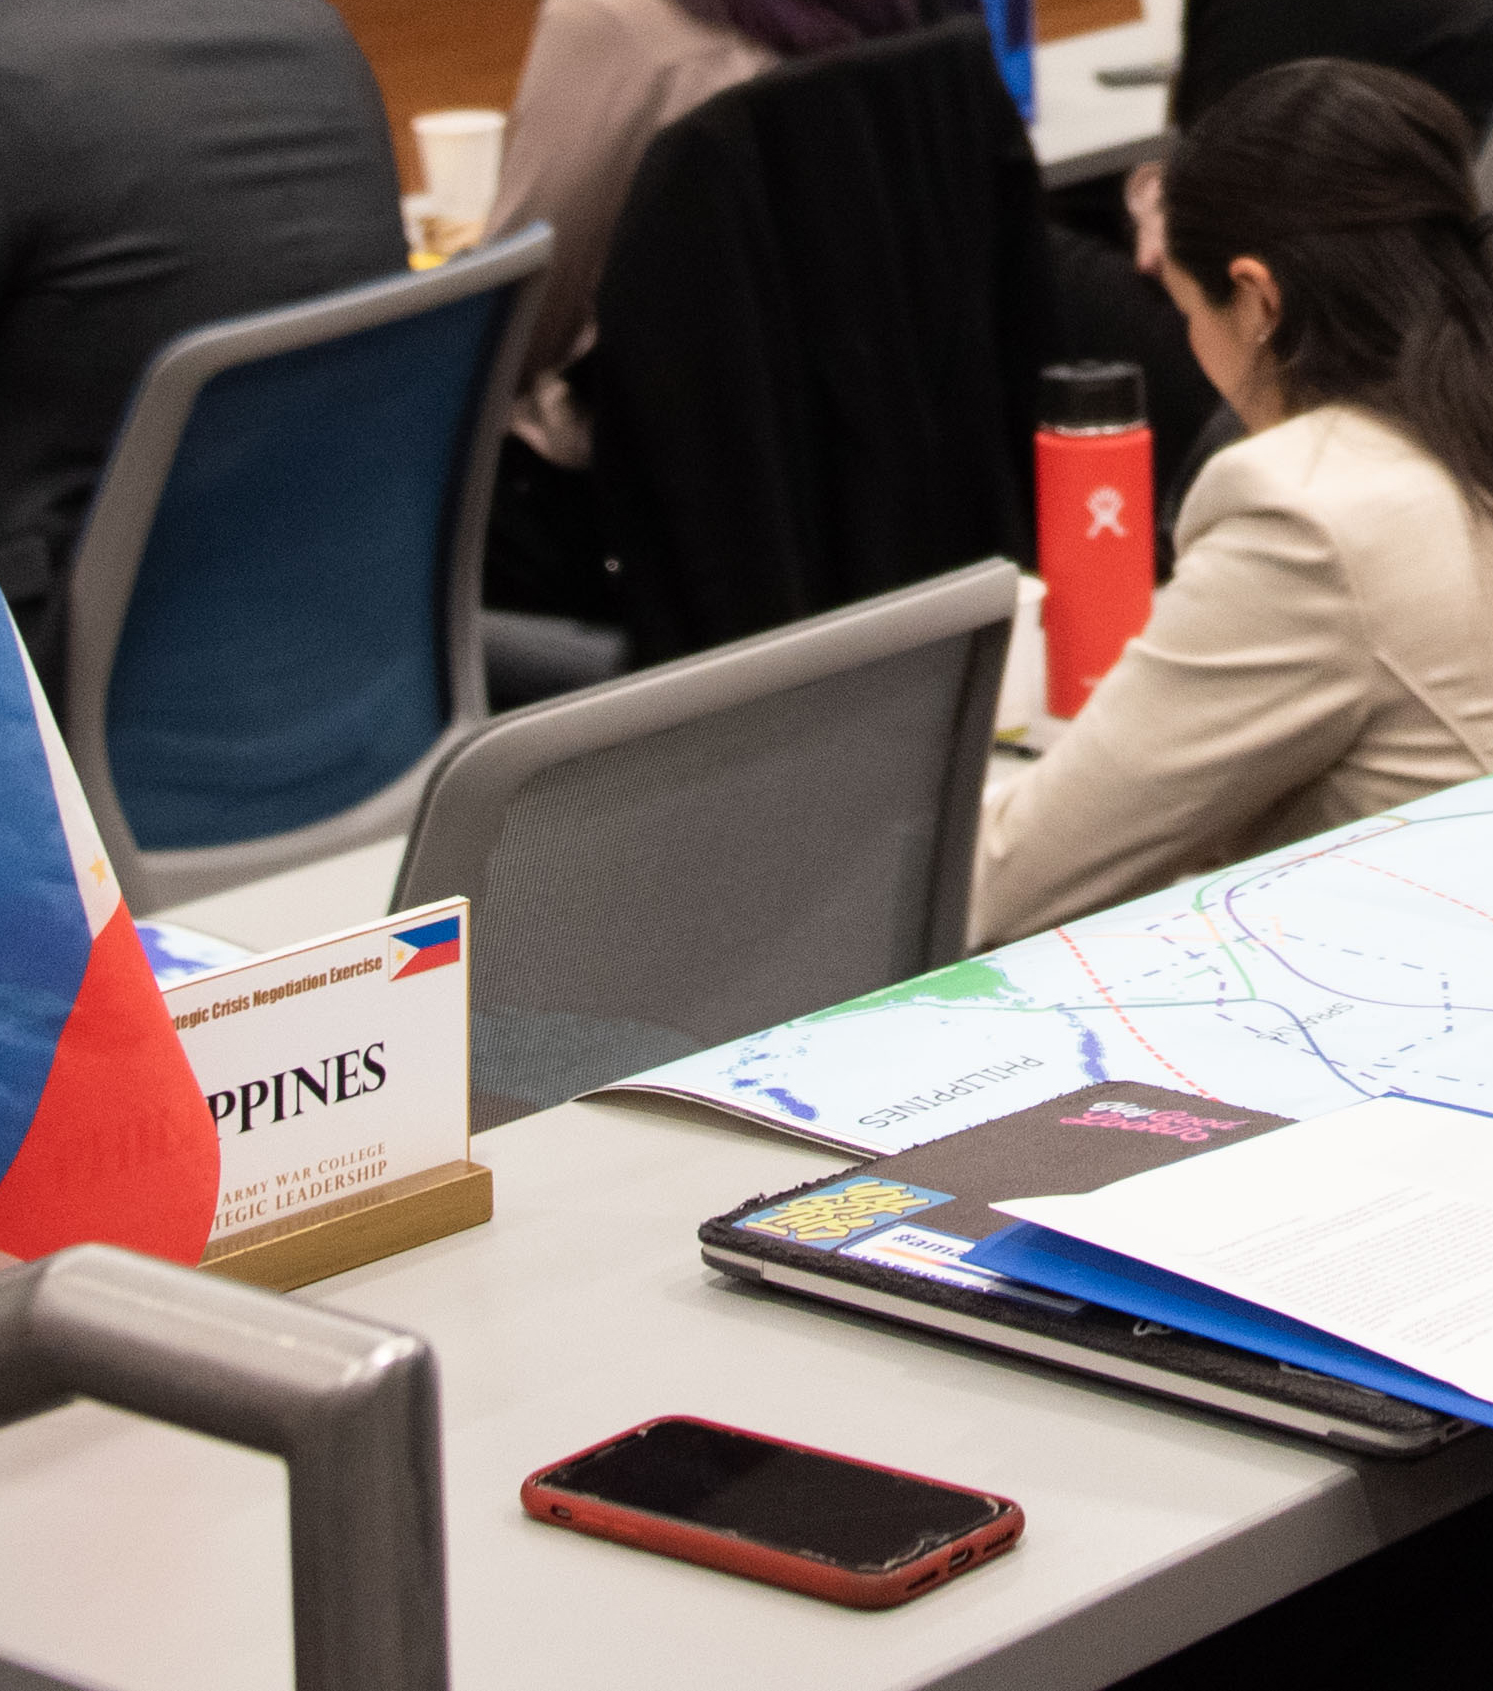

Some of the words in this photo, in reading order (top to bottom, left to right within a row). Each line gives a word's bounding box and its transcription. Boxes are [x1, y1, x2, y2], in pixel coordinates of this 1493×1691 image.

[172, 1006, 210, 1032] tegic
[212, 994, 251, 1020] Crisis
[253, 971, 328, 1008] Negotiation
[330, 955, 383, 984] Exercise
[857, 1054, 1045, 1131] PHILIPPINES
[214, 1198, 268, 1231] TEGIC
[276, 1159, 388, 1211] LEADERSHIP
[222, 1179, 269, 1207] ARMY
[276, 1166, 313, 1188] WAR
[318, 1142, 387, 1175] COLLEGE
